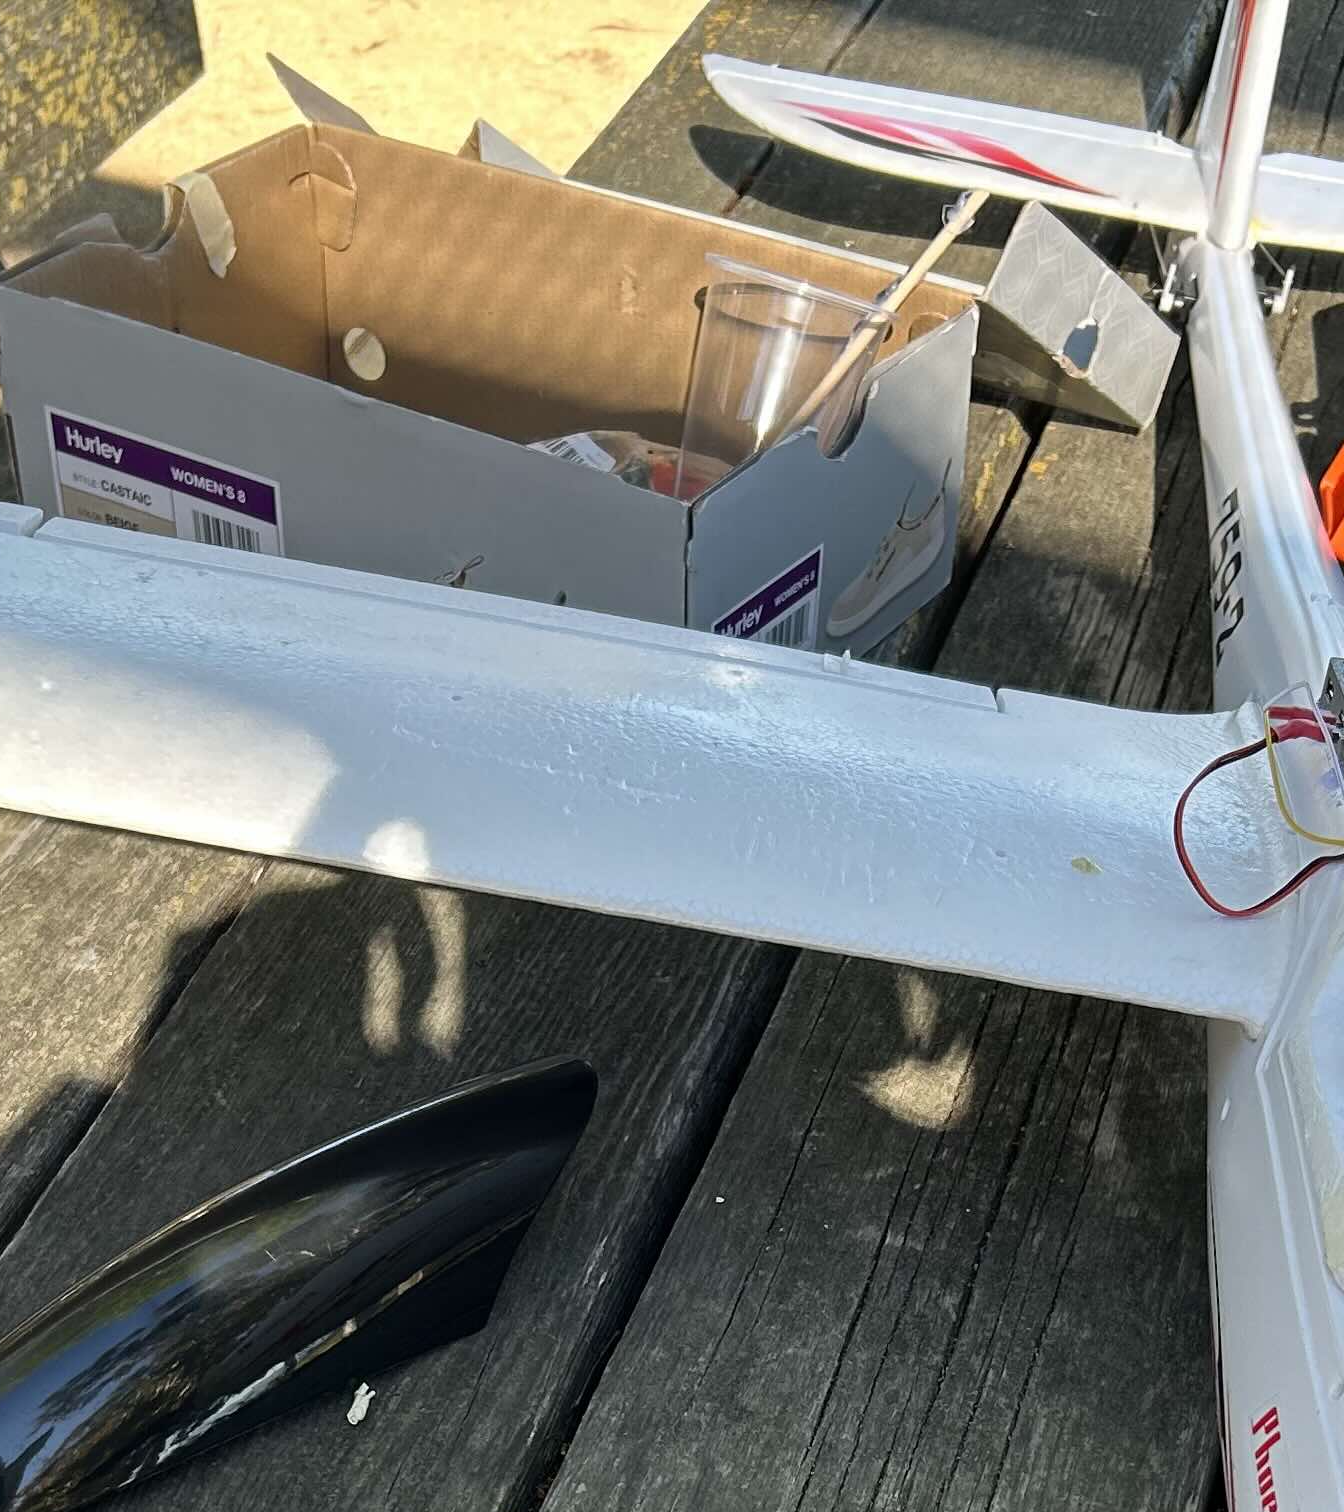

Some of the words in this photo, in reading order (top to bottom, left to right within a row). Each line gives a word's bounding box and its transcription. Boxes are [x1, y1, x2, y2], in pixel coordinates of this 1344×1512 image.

[64, 426, 124, 464] Hurley
[101, 479, 153, 507] CASTAIC
[170, 466, 235, 501] WOMEN'S
[237, 489, 247, 504] 8
